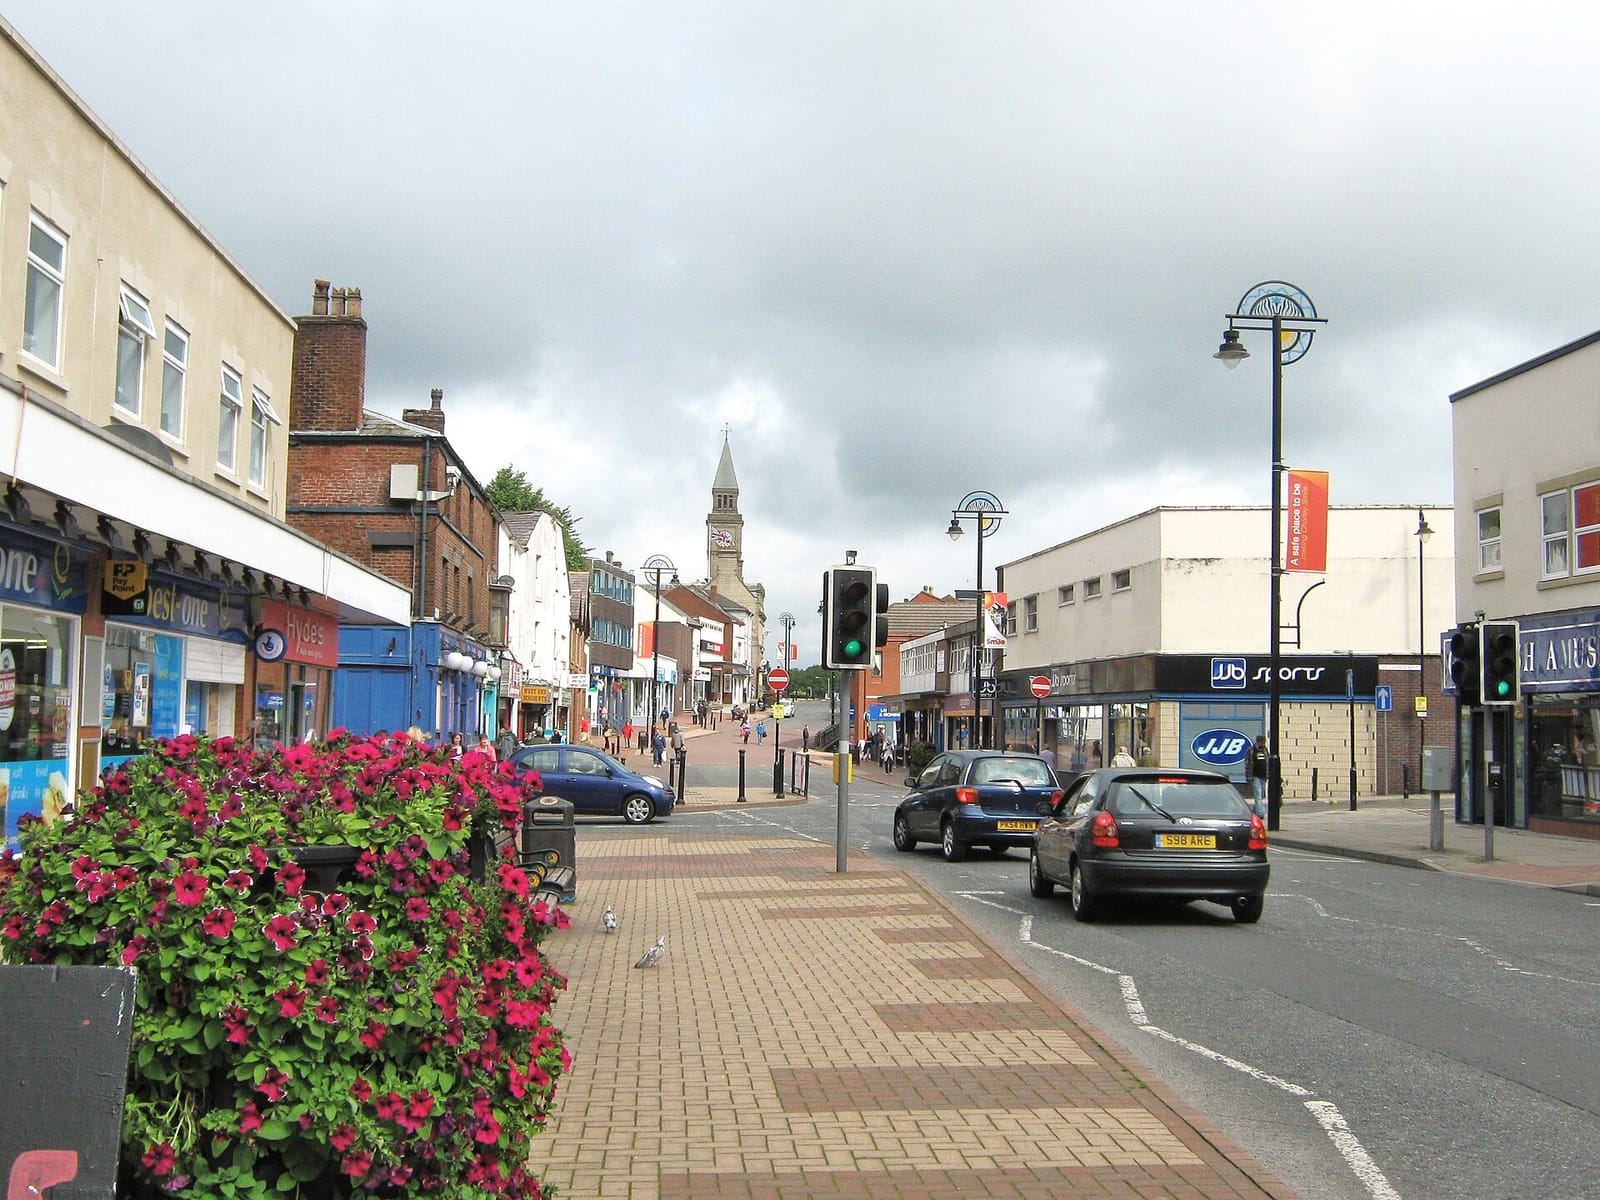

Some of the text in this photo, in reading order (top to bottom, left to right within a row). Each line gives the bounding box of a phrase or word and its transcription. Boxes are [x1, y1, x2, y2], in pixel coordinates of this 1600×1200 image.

[1290, 483, 1301, 566] A safe place to be
[112, 576, 127, 586] Pay
[112, 584, 135, 593] Point
[286, 611, 325, 654] Hyde's
[1546, 634, 1600, 671] AMUS
[1197, 738, 1246, 755] JJB
[1190, 835, 1210, 846] ARE
